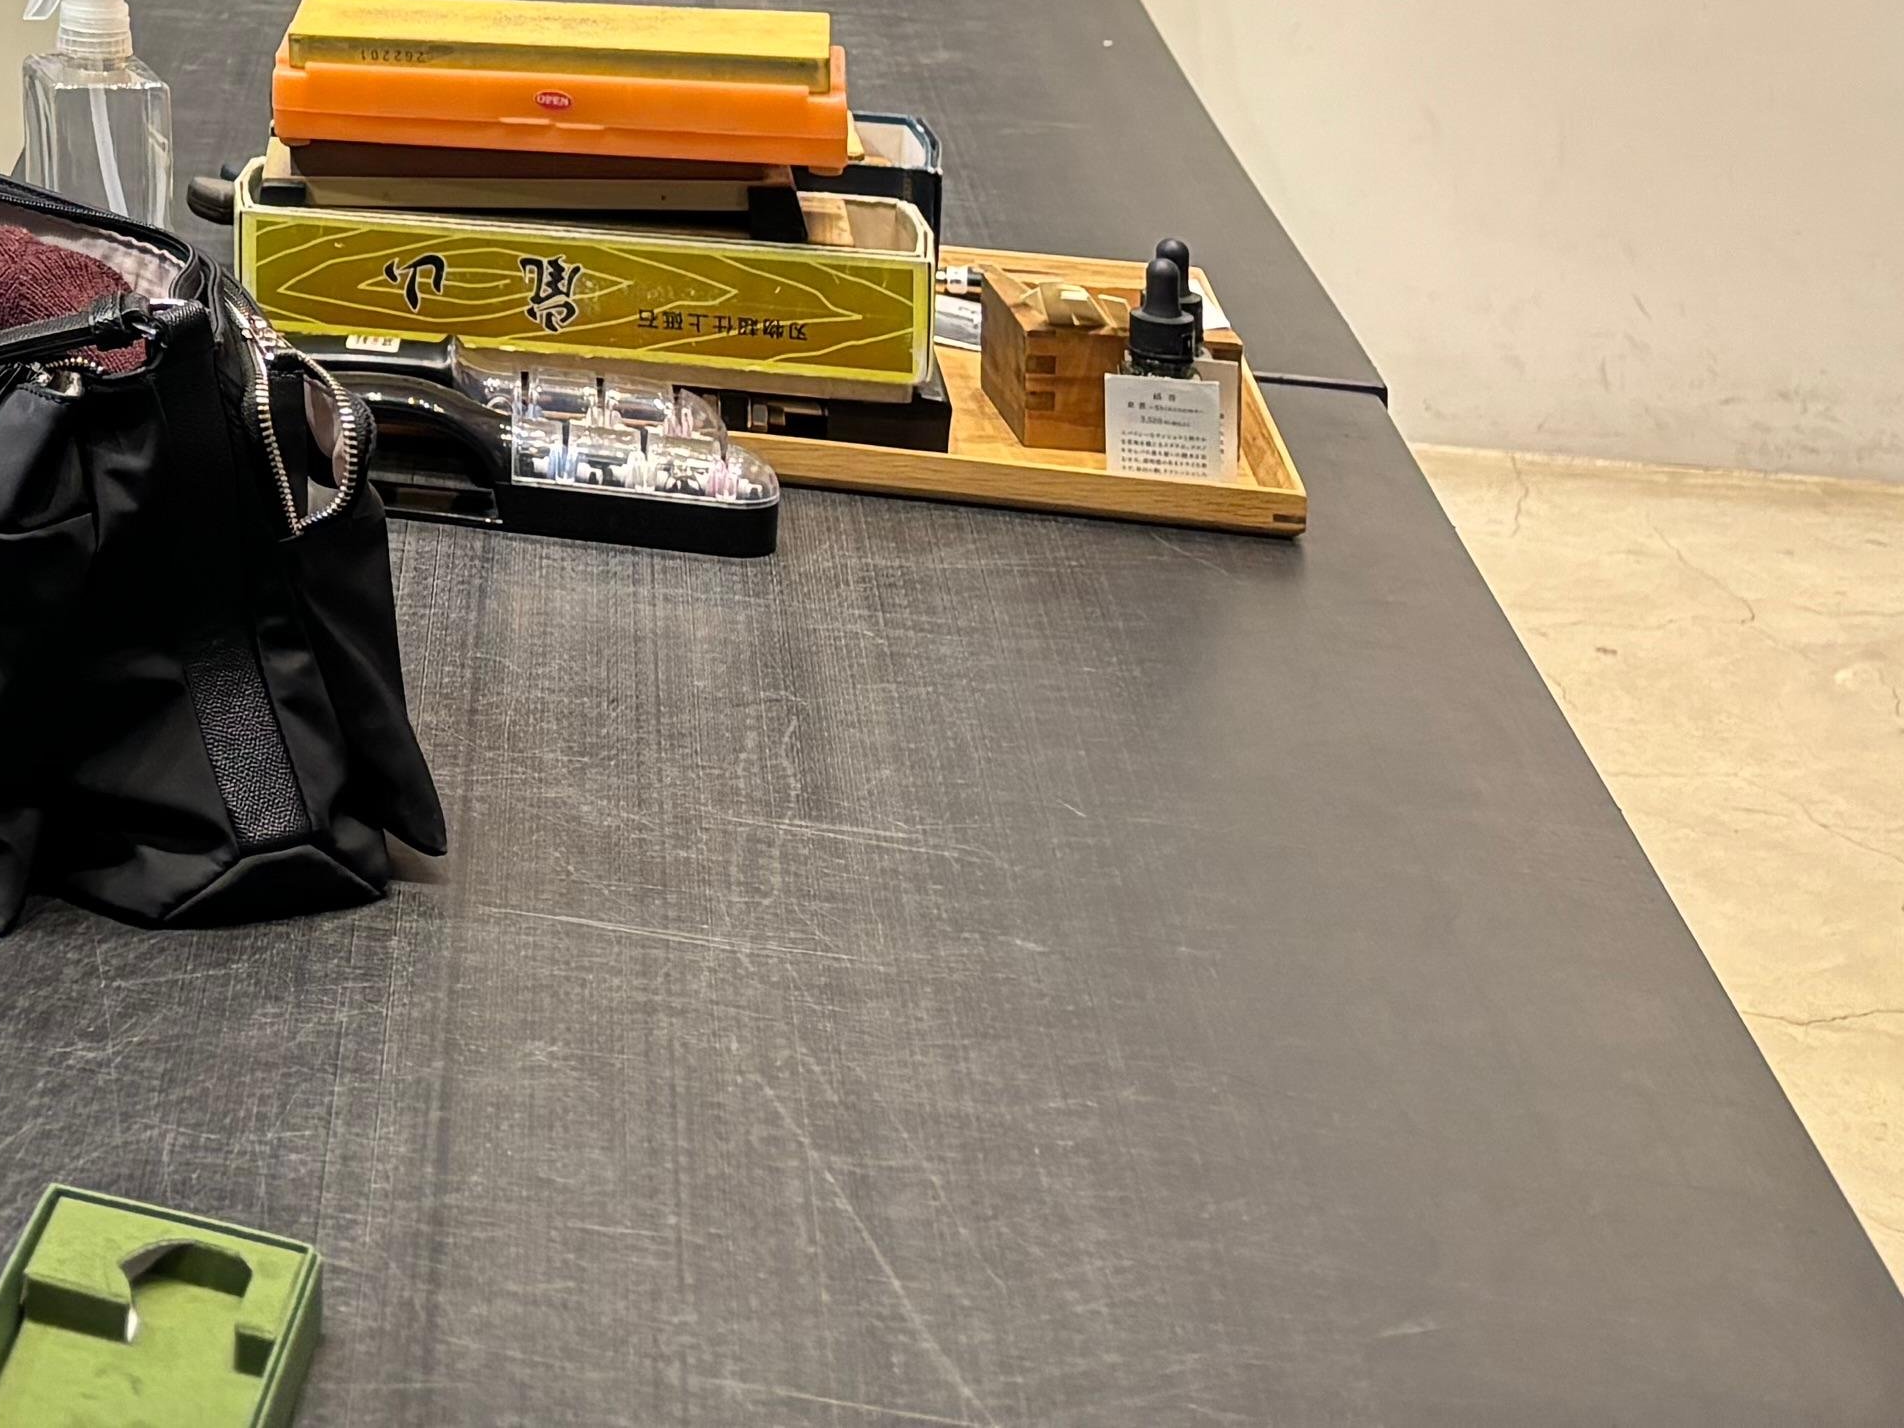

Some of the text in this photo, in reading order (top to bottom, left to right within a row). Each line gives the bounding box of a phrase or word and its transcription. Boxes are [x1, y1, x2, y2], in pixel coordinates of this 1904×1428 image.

[536, 94, 569, 106] OPEN
[637, 309, 808, 342] 刃物超仕上砥石
